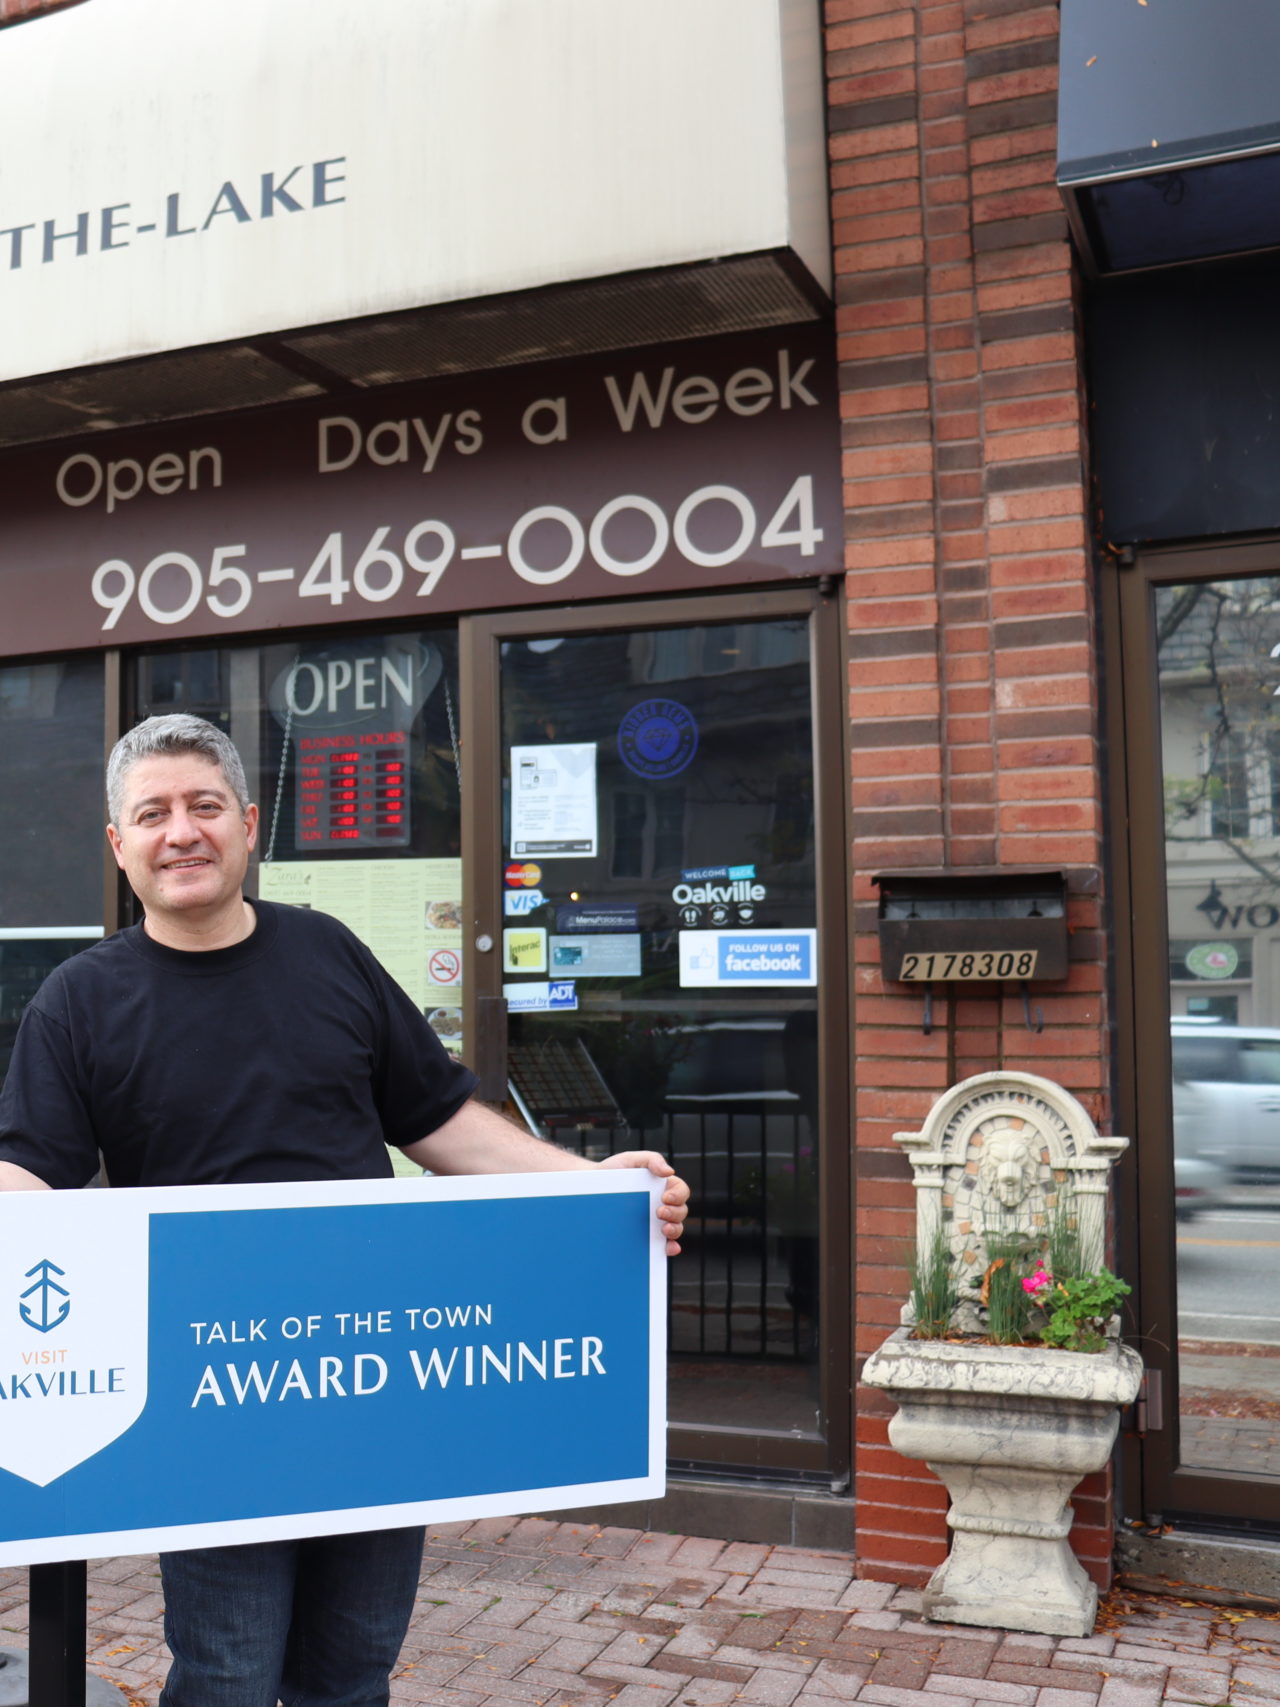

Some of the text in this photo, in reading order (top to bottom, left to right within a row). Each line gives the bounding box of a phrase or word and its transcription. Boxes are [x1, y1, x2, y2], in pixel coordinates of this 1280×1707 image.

[56, 349, 819, 513] Open Days a Week
[91, 475, 823, 631] 905-469-0004
[285, 655, 413, 716] OPEN
[300, 731, 406, 750] BUSINESS HOURS
[685, 869, 727, 879] WELCOME
[672, 880, 766, 905] Oakville
[729, 943, 800, 953] FOLLOW US ON
[725, 954, 802, 971] facebook
[903, 952, 1034, 980] 2178308
[508, 998, 537, 1007] ecured
[550, 985, 574, 1000] ADT
[190, 1304, 492, 1345] TALK OF THE TOWN
[22, 1350, 68, 1365] VISIT
[190, 1336, 607, 1408] AWARD WINNER
